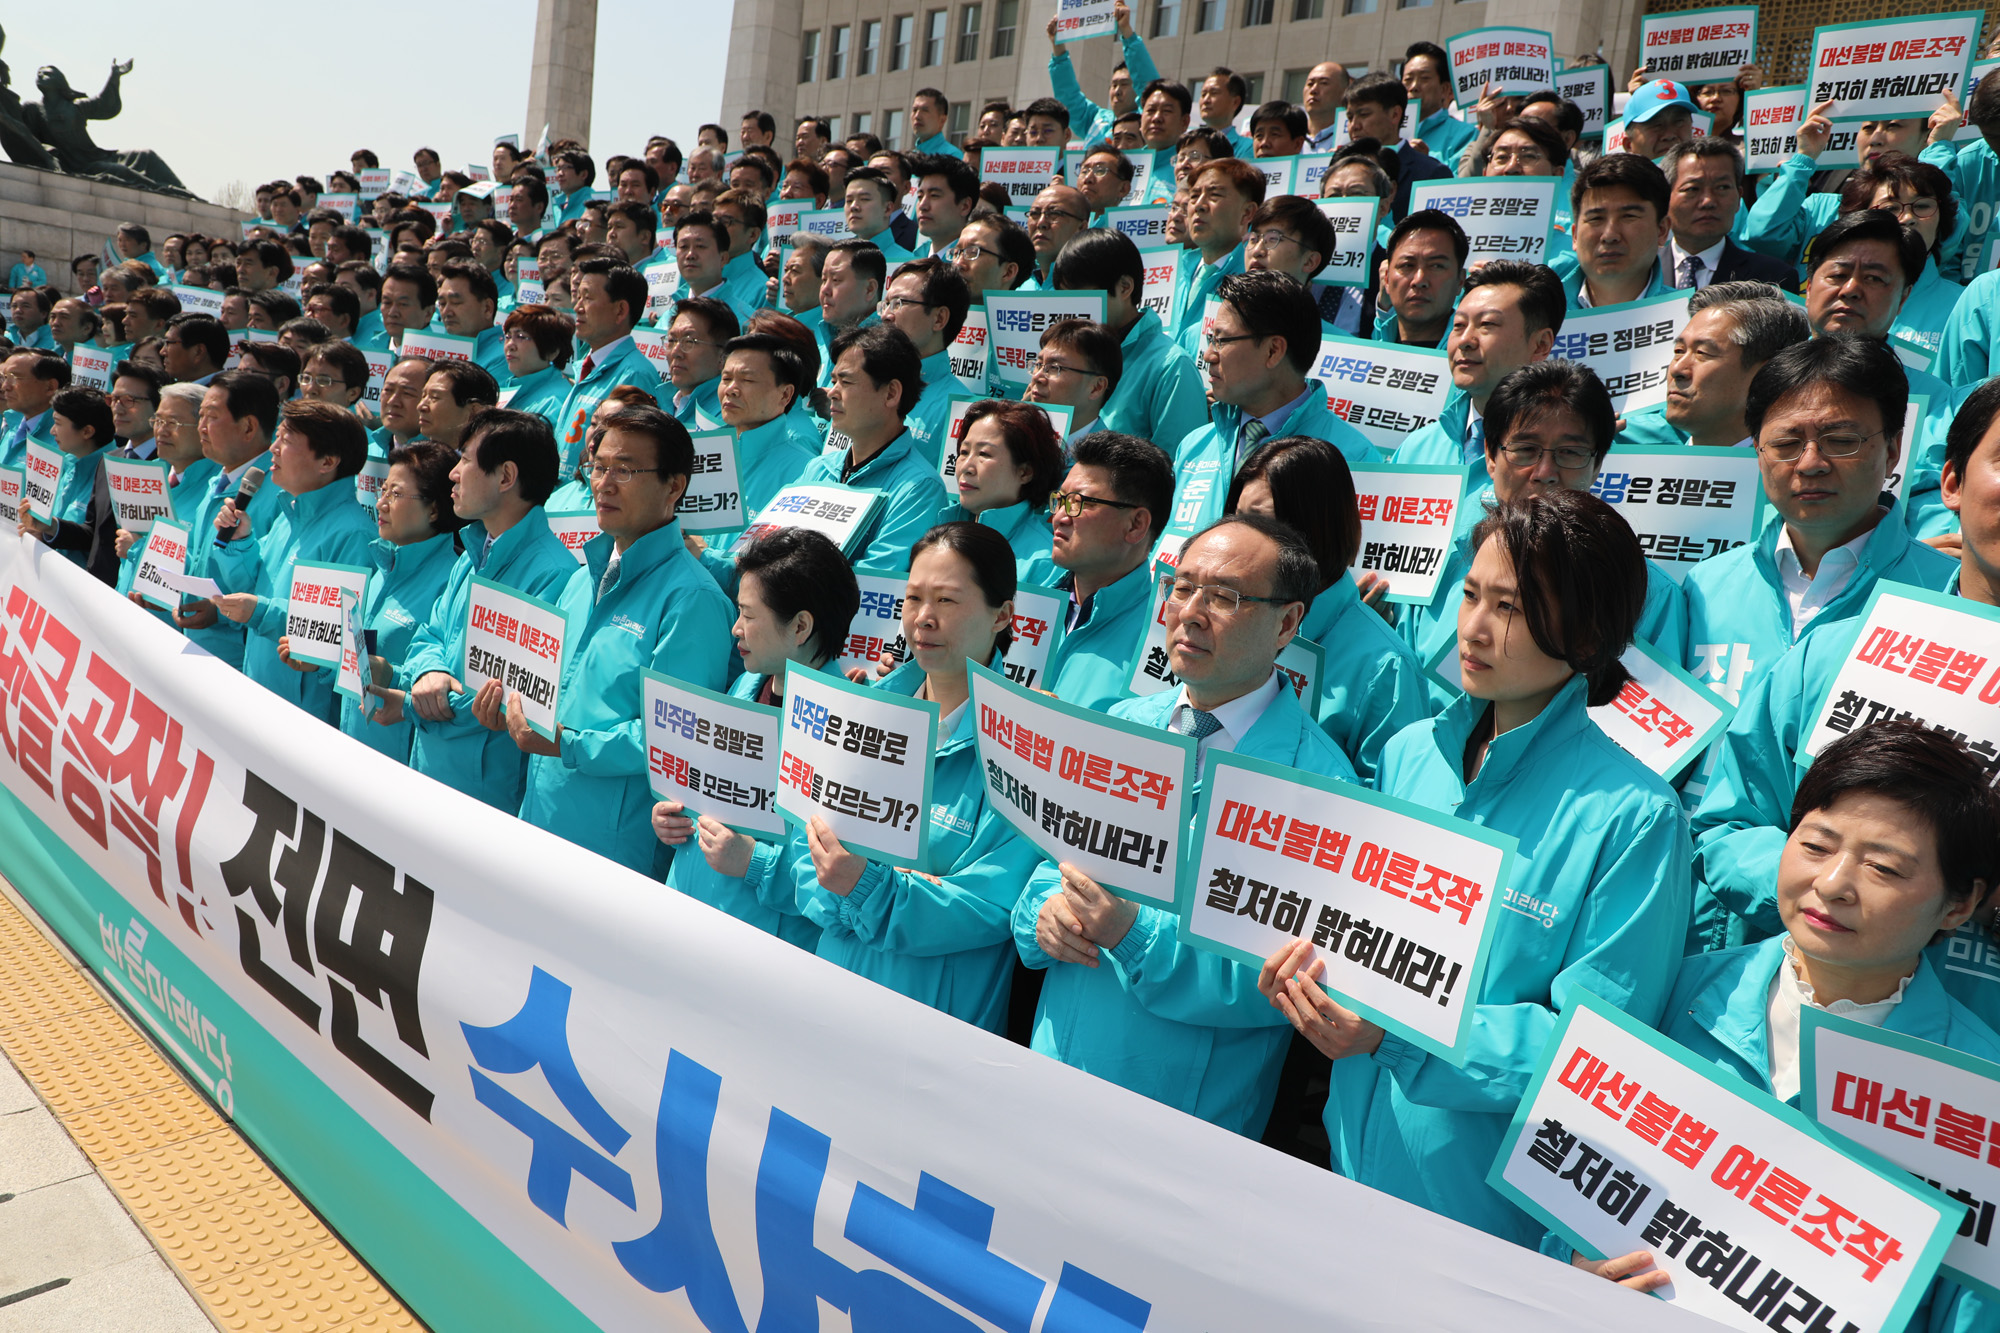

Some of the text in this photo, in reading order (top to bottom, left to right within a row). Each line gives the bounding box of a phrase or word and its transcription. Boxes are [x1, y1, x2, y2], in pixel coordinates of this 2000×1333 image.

[1646, 23, 1750, 47] 대선불법 여론조작
[1454, 41, 1548, 67] 대선불법 여론조작
[1645, 50, 1748, 74] 철저히 밝혀내라!
[1819, 35, 1967, 68] 대선불법 여론조작
[1458, 66, 1549, 93] 철저히 밝혀내라!
[1563, 81, 1596, 98] 정말로
[1655, 79, 1678, 100] 3
[1814, 72, 1959, 103] 철저히 밝혀내라!
[1750, 105, 1795, 126] 대선불법
[1750, 137, 1781, 156] 철저히
[985, 160, 1053, 174] 대선불법 여론조작
[1489, 198, 1539, 217] 정말로
[808, 220, 843, 235] 민주당은
[1117, 220, 1159, 238] 민주당은
[1472, 235, 1544, 255] 모르는가?
[997, 310, 1045, 332] 민주당은
[1612, 320, 1674, 353] 정말로
[1318, 354, 1440, 395] 민주당은 정말로
[565, 408, 587, 444] 3
[123, 475, 163, 496] 여론조작
[1656, 477, 1737, 509] 정말로
[769, 494, 858, 524] 민주당은 정말로
[1382, 496, 1454, 527] 여론조작
[149, 534, 179, 559] 대선불법
[1362, 541, 1443, 578] 밝혀내라!
[292, 581, 322, 605] 대선불법
[288, 614, 310, 639] 철저히
[471, 604, 561, 664] 대선불법 여론조작
[1856, 626, 1989, 696] 대선불법
[468, 645, 556, 711] 철저히 밝혀내라!
[655, 698, 764, 761] 민주당은 정말로
[791, 694, 909, 766] 민주당은 정말로
[980, 702, 1175, 811] 대선불법 여론조작
[649, 745, 777, 814] 드루킹을 모르는가?
[779, 750, 920, 832] 드루킹을 모르는가?
[986, 758, 1169, 874] 철저히 밝혀내라!
[1216, 799, 1484, 926] 대선불법 여론조작
[219, 768, 437, 1126] 전면
[1205, 867, 1463, 1007] 철저히 밝혀내라!
[100, 909, 235, 1121] 바른미래당
[1831, 1071, 2000, 1170] 대선불
[1556, 1046, 1719, 1171] 대선불법
[1710, 1143, 1905, 1284] 여론조작
[1526, 1117, 1653, 1227] 철저히
[1639, 1198, 1862, 1333] 밝혀내라
